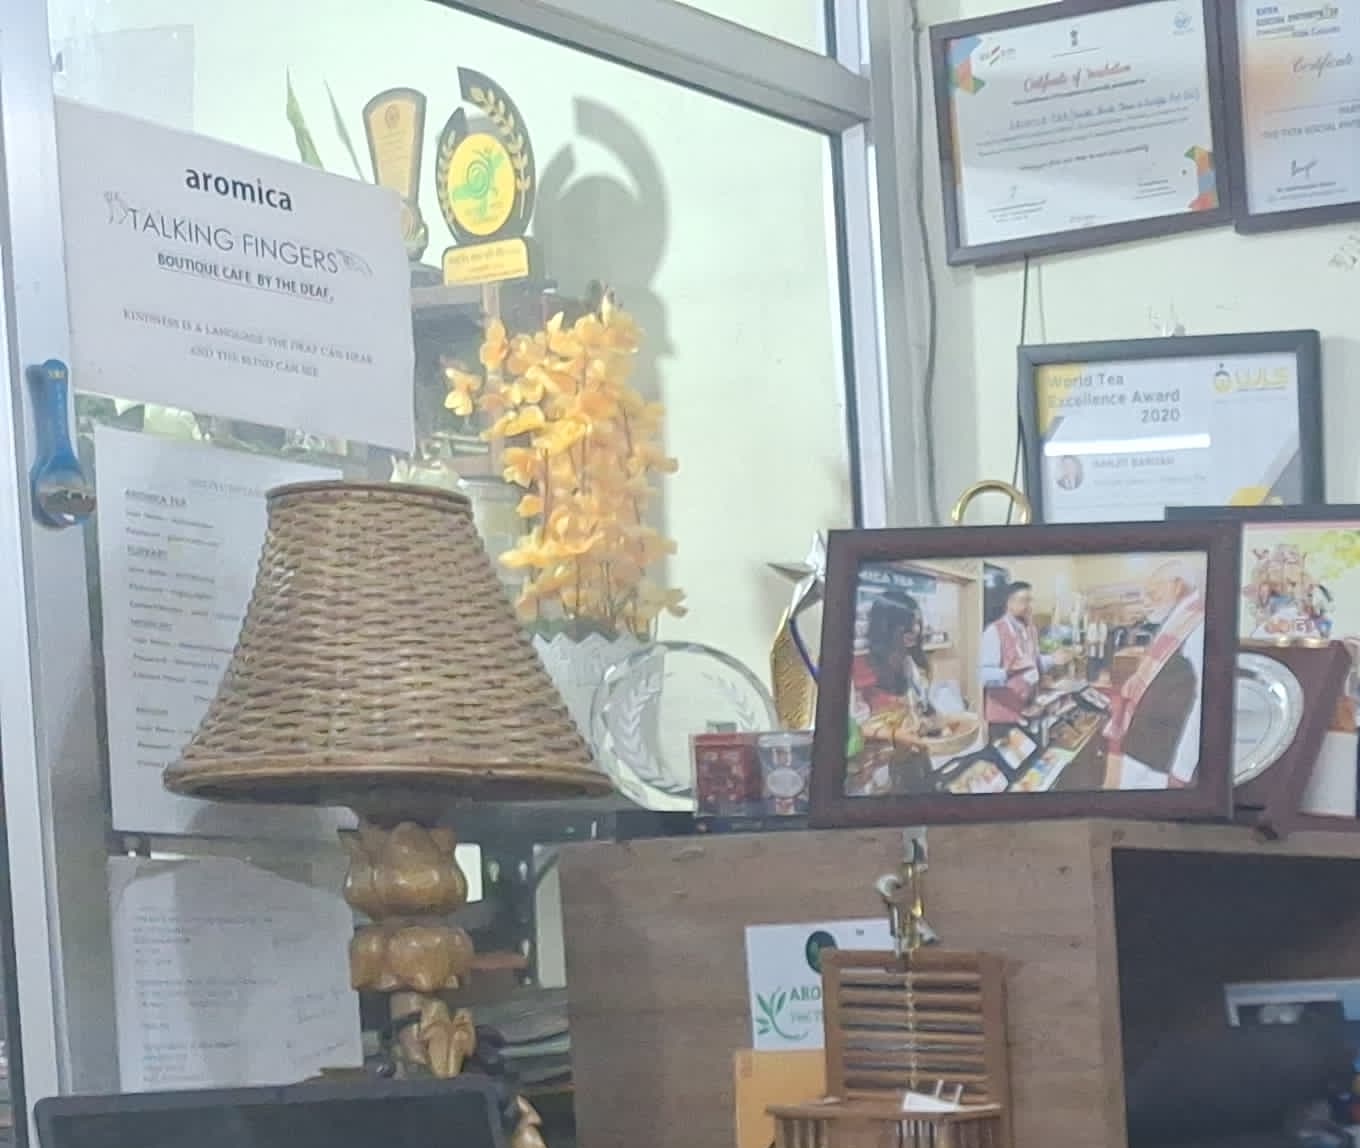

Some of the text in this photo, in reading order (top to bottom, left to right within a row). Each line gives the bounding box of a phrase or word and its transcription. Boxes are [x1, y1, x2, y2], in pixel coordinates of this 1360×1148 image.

[185, 168, 293, 211] aromica
[127, 207, 338, 274] TALKING FINGERS
[157, 253, 219, 277] BOUTIQUE
[222, 266, 251, 284] CAFE
[257, 274, 272, 287] BY
[275, 277, 297, 293] THE
[123, 309, 179, 329] KINDNESS
[205, 324, 263, 345] LANGUAGE
[267, 335, 288, 350] THE
[1050, 372, 1124, 388] World Tea
[1048, 389, 1180, 409] Excellence Award
[1140, 407, 1180, 424] 2020
[790, 985, 821, 1001] ARO
